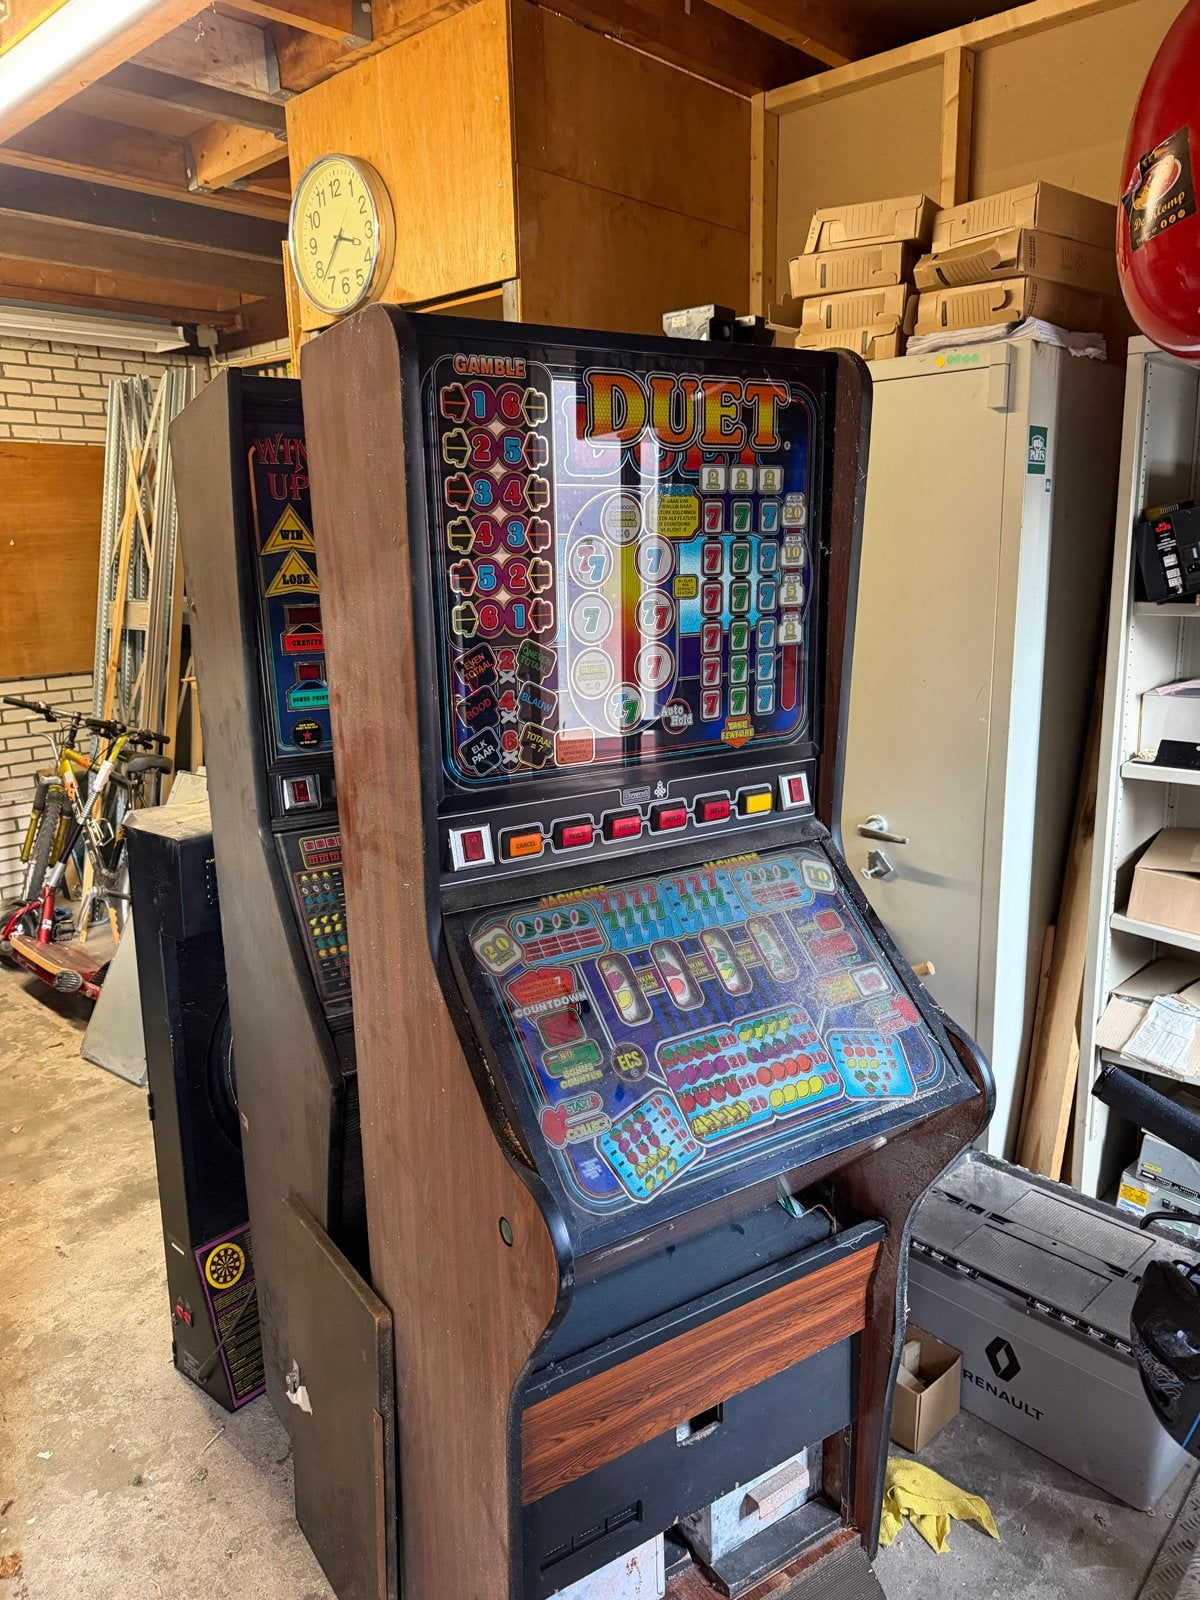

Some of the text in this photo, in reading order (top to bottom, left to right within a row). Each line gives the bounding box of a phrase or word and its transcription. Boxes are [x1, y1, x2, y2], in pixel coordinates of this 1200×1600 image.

[329, 178, 341, 198] 12
[348, 180, 354, 197] 1
[316, 189, 326, 208] 11
[358, 195, 367, 214] 2
[306, 210, 321, 230] 10
[365, 220, 373, 239] 3
[309, 237, 318, 255] 9
[364, 247, 373, 264] 4
[316, 260, 324, 278] 8
[356, 269, 364, 286] 5
[328, 276, 336, 294] 7
[342, 276, 350, 294] 6
[453, 353, 526, 378] GAMBLE
[472, 390, 521, 419] 1 6
[584, 368, 790, 450] DUET
[472, 434, 522, 464] 2 5
[1029, 450, 1045, 461] PARTS
[267, 472, 309, 500] UP
[710, 472, 717, 483] 2
[738, 472, 746, 484] 2
[766, 473, 774, 484] 2
[474, 479, 522, 506] 3 4
[706, 506, 776, 529] 7 7 7
[786, 507, 801, 518] 20
[279, 530, 304, 541] WIN
[476, 521, 526, 548] 4 3
[646, 548, 663, 574] 7
[706, 546, 775, 570] 7 7 7
[786, 548, 800, 558] 10
[577, 545, 606, 582] 7 7
[282, 574, 310, 585] LOSE
[477, 563, 527, 590] 5 2
[706, 585, 774, 610] 7 7 7
[788, 586, 796, 596] 5
[480, 603, 526, 630] 6 1
[583, 606, 601, 633] 7
[654, 606, 670, 631] 7
[705, 624, 773, 649] 7 7 7
[464, 652, 485, 670] EVEN
[498, 648, 516, 671] 2
[646, 655, 663, 680] 7
[464, 661, 493, 681] TOTAAL
[705, 658, 771, 682] 7 7 7
[465, 698, 492, 720] ROOD
[498, 690, 517, 712] 4
[521, 692, 552, 712] BLAUW
[661, 704, 684, 716] Auto
[706, 689, 771, 715] 7 7 7
[623, 700, 639, 724] 7
[671, 714, 693, 726] Hold
[728, 720, 748, 730] TAKE
[502, 730, 519, 752] 6
[526, 731, 552, 748] TOTAAL
[721, 729, 755, 740] FEATURE
[471, 740, 488, 755] ELK
[472, 744, 496, 765] PAAR
[666, 814, 681, 823] HOLD
[710, 806, 725, 814] HOLD
[569, 831, 587, 840] HOLD
[516, 840, 536, 850] CANCEL
[809, 868, 828, 881] 10
[482, 935, 510, 962] 20
[688, 959, 705, 970] WIN
[638, 974, 652, 983] WIN
[513, 990, 587, 1018] COUNTDOWN
[717, 1032, 738, 1049] 20
[800, 1031, 818, 1045] 20
[727, 1051, 748, 1068] 20
[811, 1050, 828, 1064] 10
[560, 1070, 603, 1089] COUNTER
[562, 1063, 594, 1079] BONUS
[820, 1071, 839, 1086] 10
[736, 1073, 758, 1090] 20
[565, 1097, 592, 1114] START
[749, 1095, 769, 1112] 20
[566, 1116, 610, 1141] COLLECT
[962, 1368, 1044, 1421] RENAULT
